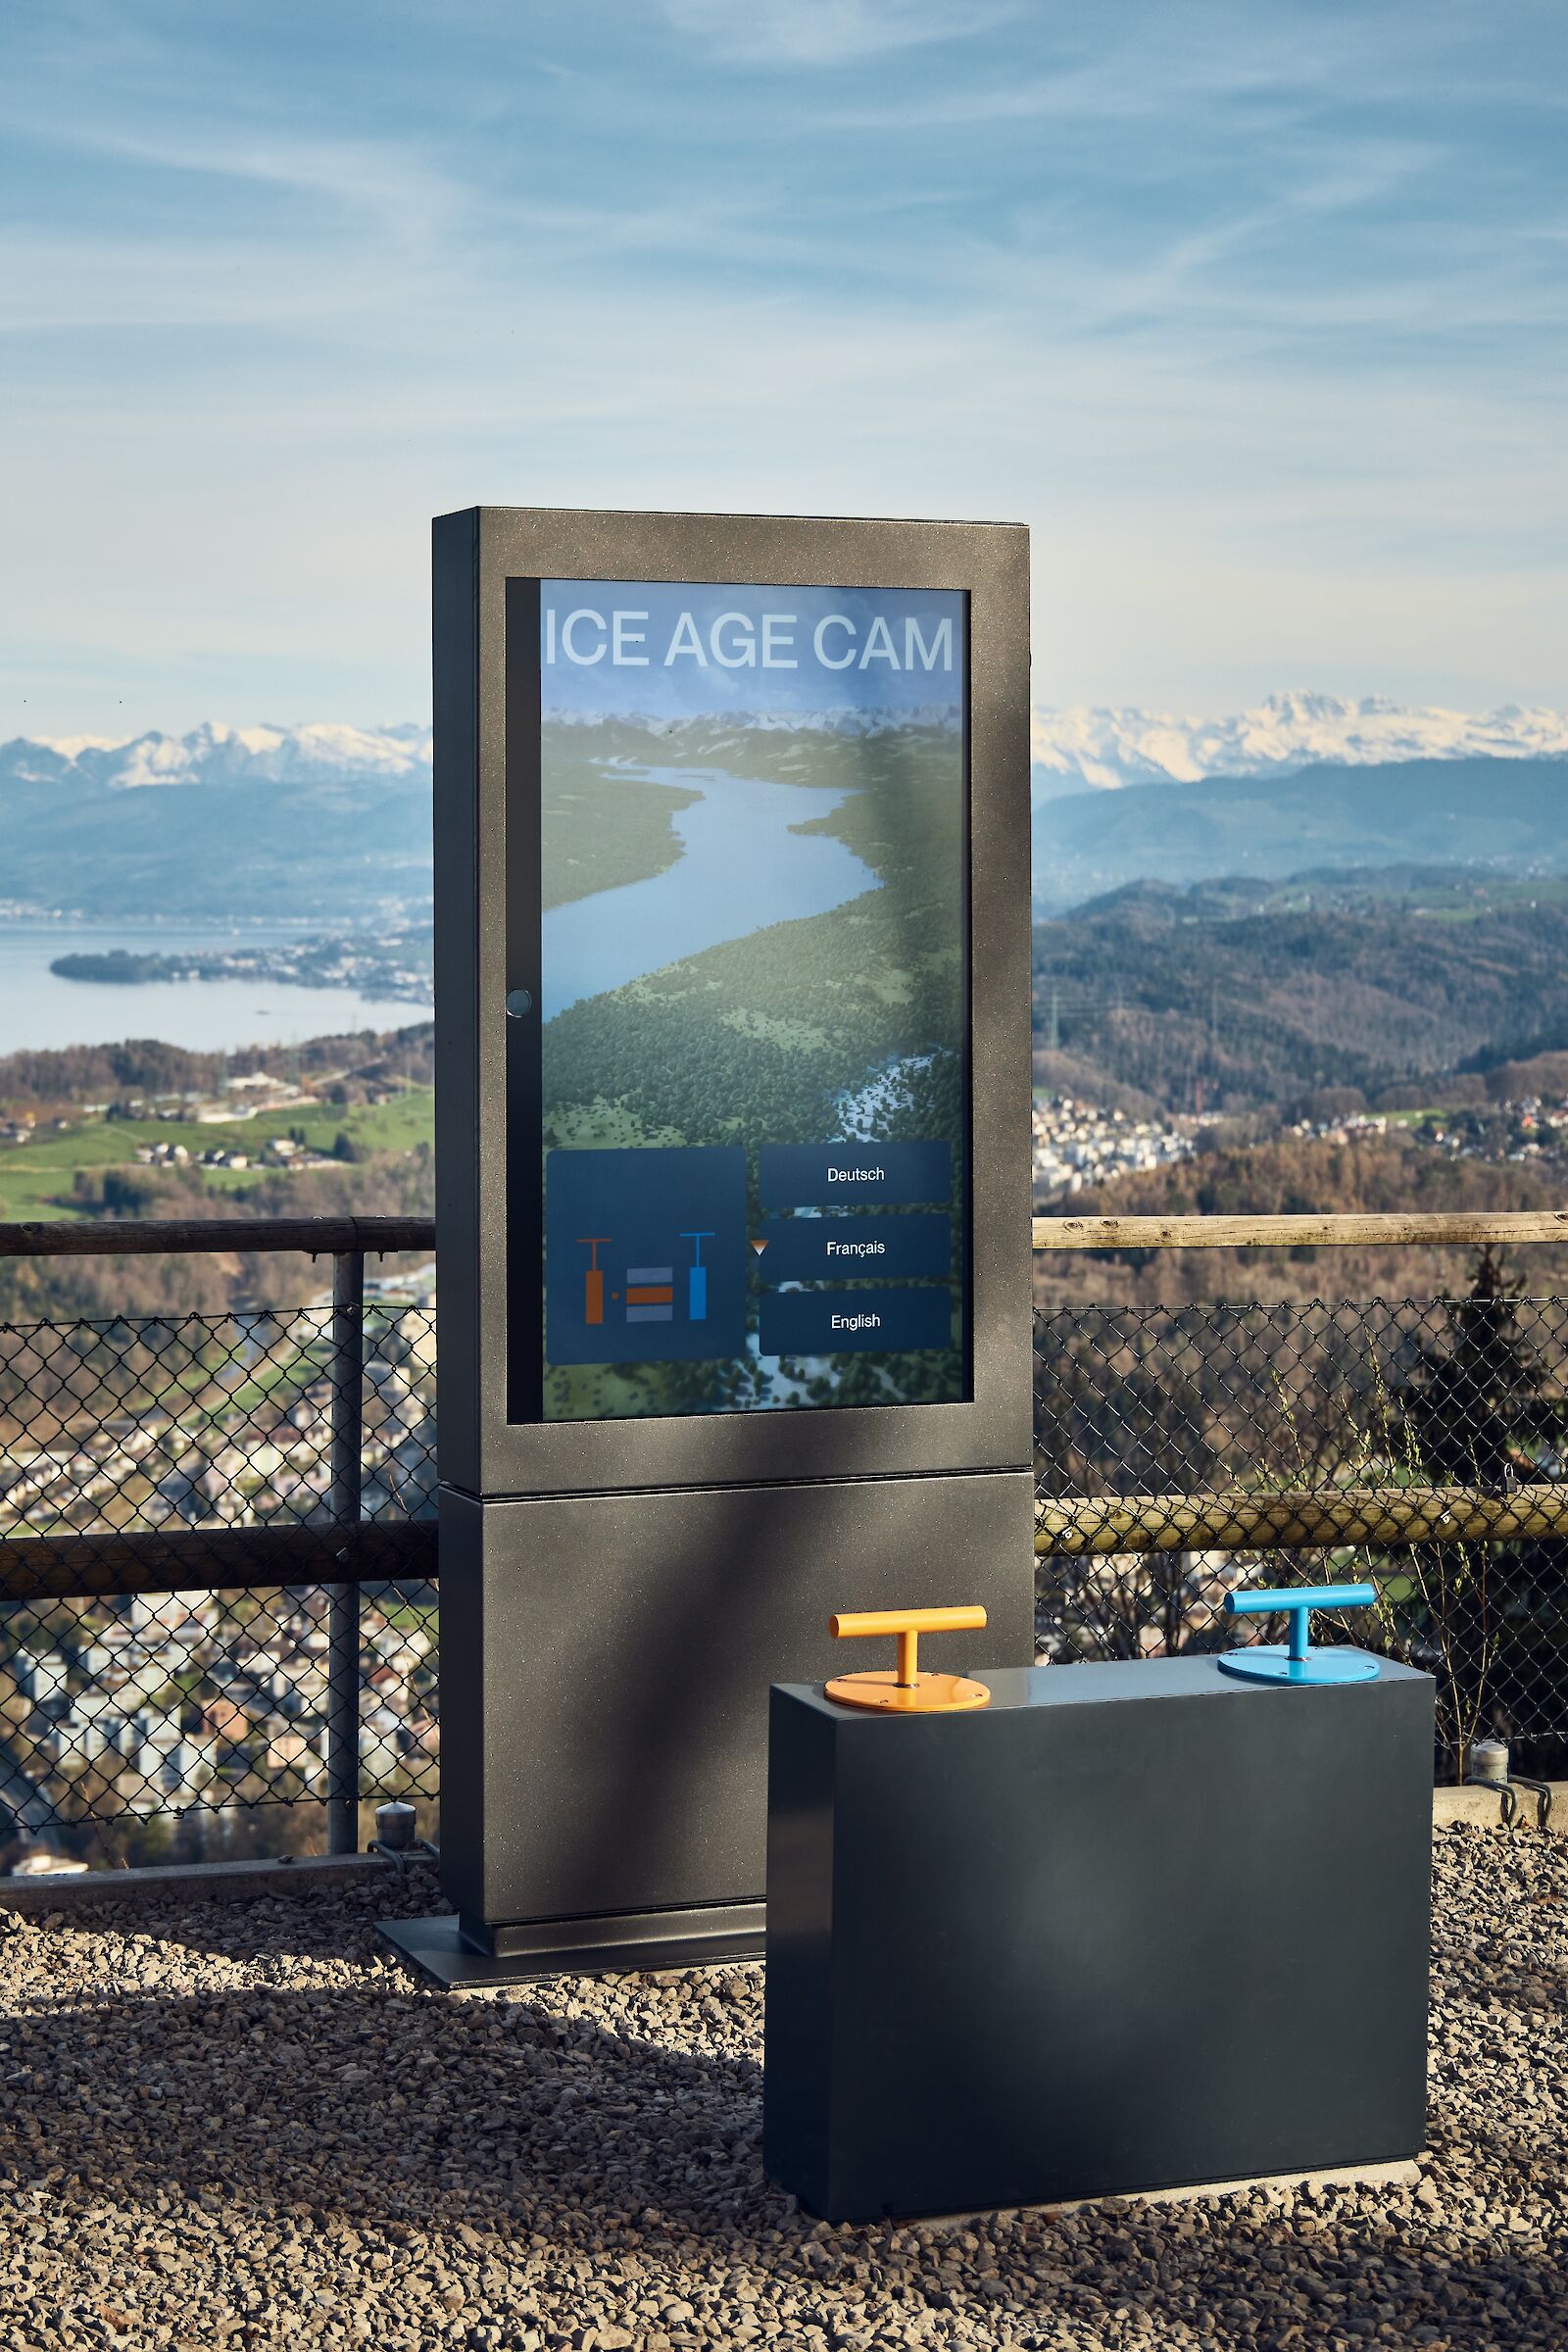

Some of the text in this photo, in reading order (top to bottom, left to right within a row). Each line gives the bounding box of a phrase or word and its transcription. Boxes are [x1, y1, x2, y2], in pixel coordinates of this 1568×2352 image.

[546, 609, 953, 671] ICE AGE CAM
[827, 1167, 885, 1182] Deutsch
[826, 1241, 886, 1257] Français
[831, 1314, 881, 1331] English
